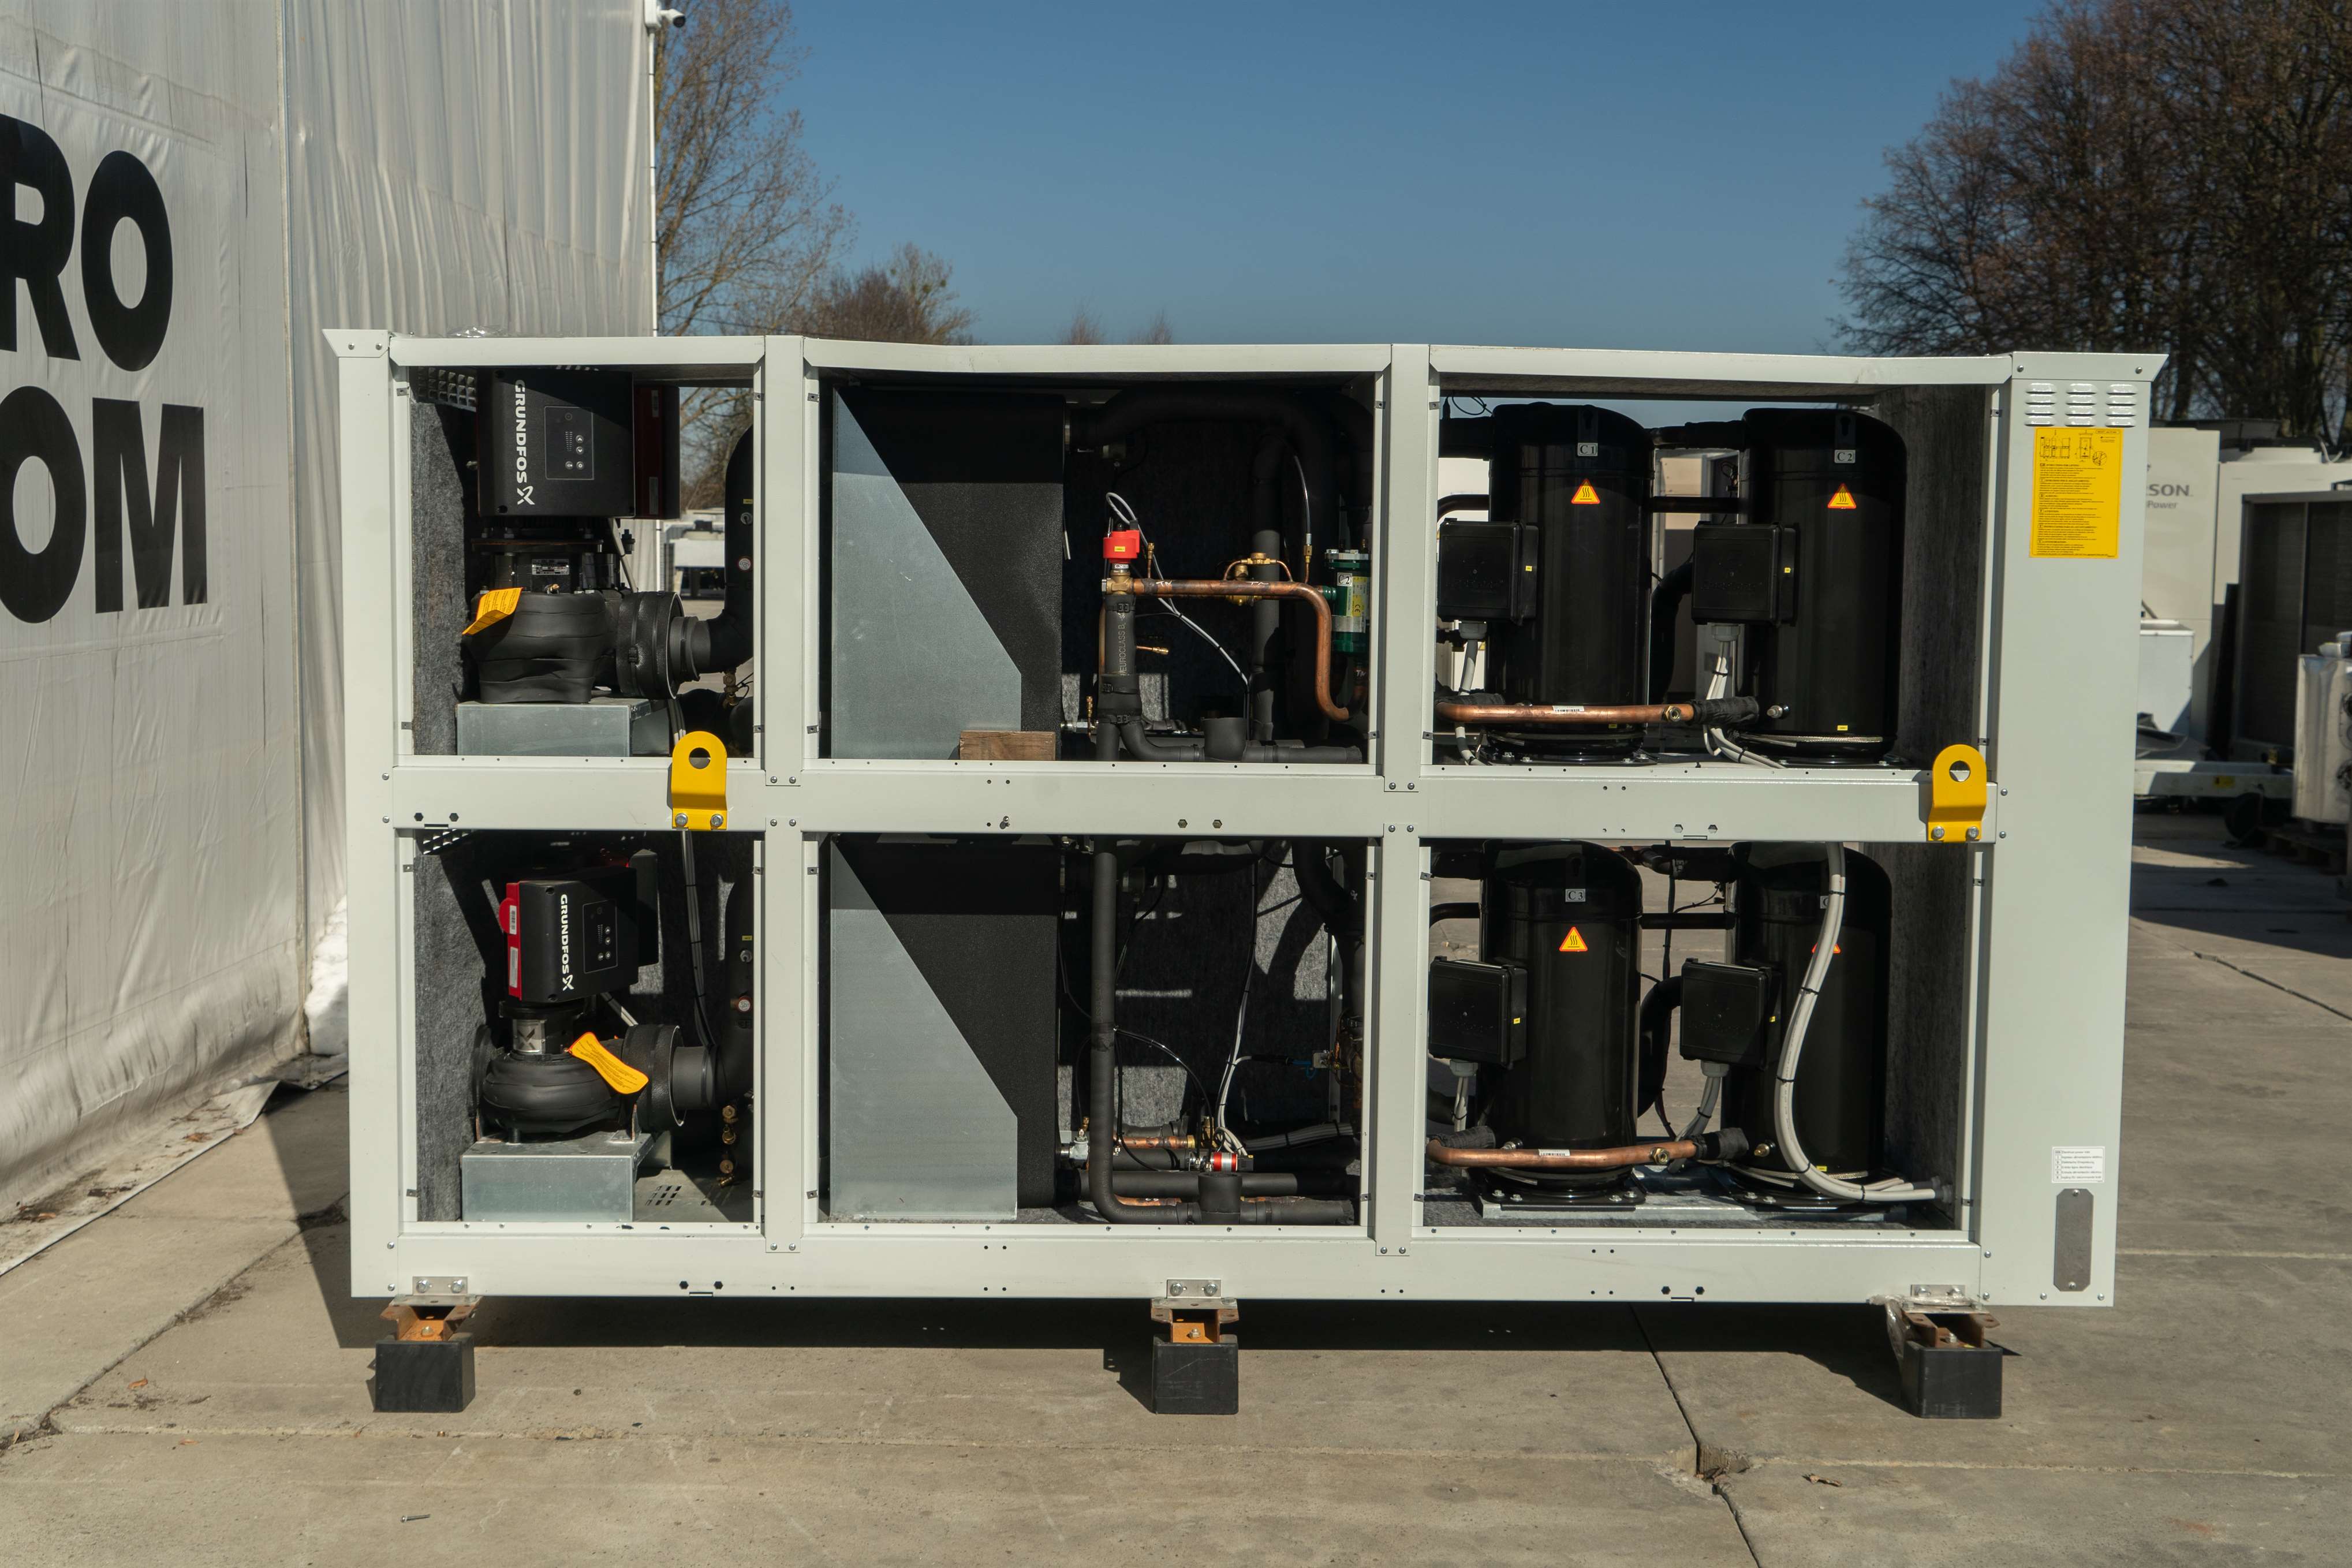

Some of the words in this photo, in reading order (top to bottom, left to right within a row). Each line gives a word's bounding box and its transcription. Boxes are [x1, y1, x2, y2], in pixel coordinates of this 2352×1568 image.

[515, 379, 527, 483] GRUNDFOS
[2146, 484, 2189, 496] SON
[561, 894, 569, 975] GRUNDFOS
